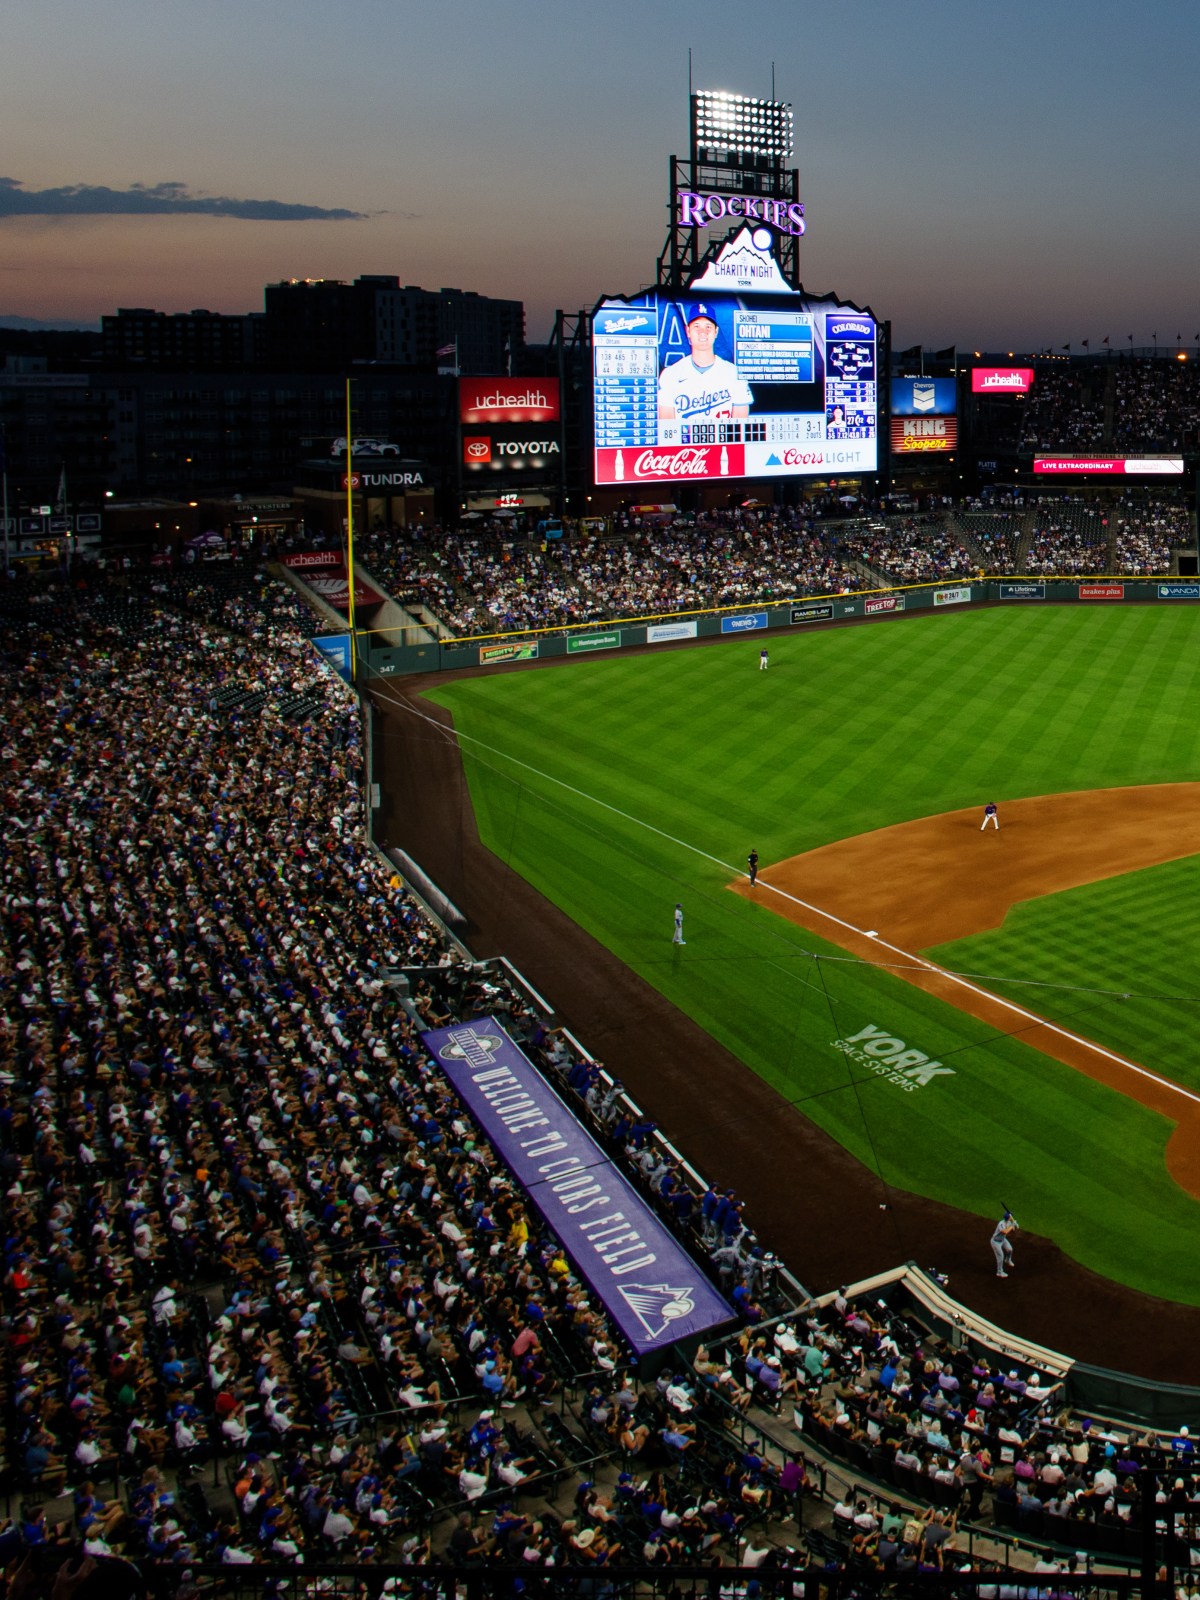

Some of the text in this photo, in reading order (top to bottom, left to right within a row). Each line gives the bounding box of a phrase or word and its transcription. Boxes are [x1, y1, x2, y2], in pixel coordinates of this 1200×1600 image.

[677, 192, 807, 236] ROCKIES
[715, 263, 774, 279] CHARITY NIGHT
[739, 314, 758, 323] SHOHEI
[739, 325, 771, 338] OHTANI
[832, 322, 870, 334] COLORADO
[984, 373, 1022, 385] uchealth
[476, 390, 547, 408] uchealth
[675, 389, 731, 416] Dodgers
[903, 419, 946, 436] KING
[496, 441, 560, 455] TOYOTA
[904, 436, 946, 450] Soopers
[634, 447, 711, 477] Coca-Cola
[783, 448, 861, 466] Coors LIGHT
[978, 460, 997, 468] PLATTE
[362, 472, 424, 486] TUNDRA
[286, 552, 336, 567] uchealth
[948, 591, 959, 600] 24/7
[1104, 588, 1121, 596] plus
[866, 598, 896, 612] TREE TOP
[794, 610, 817, 618] RAMOS
[578, 639, 604, 647] Huntington
[485, 646, 514, 658] MIGHTY
[379, 665, 396, 673] 347
[830, 1039, 871, 1062] SPACE
[844, 1023, 957, 1087] YORK
[863, 1060, 920, 1092] SYSTEMS
[472, 1066, 658, 1276] WELCOME TO COORS FIELD
